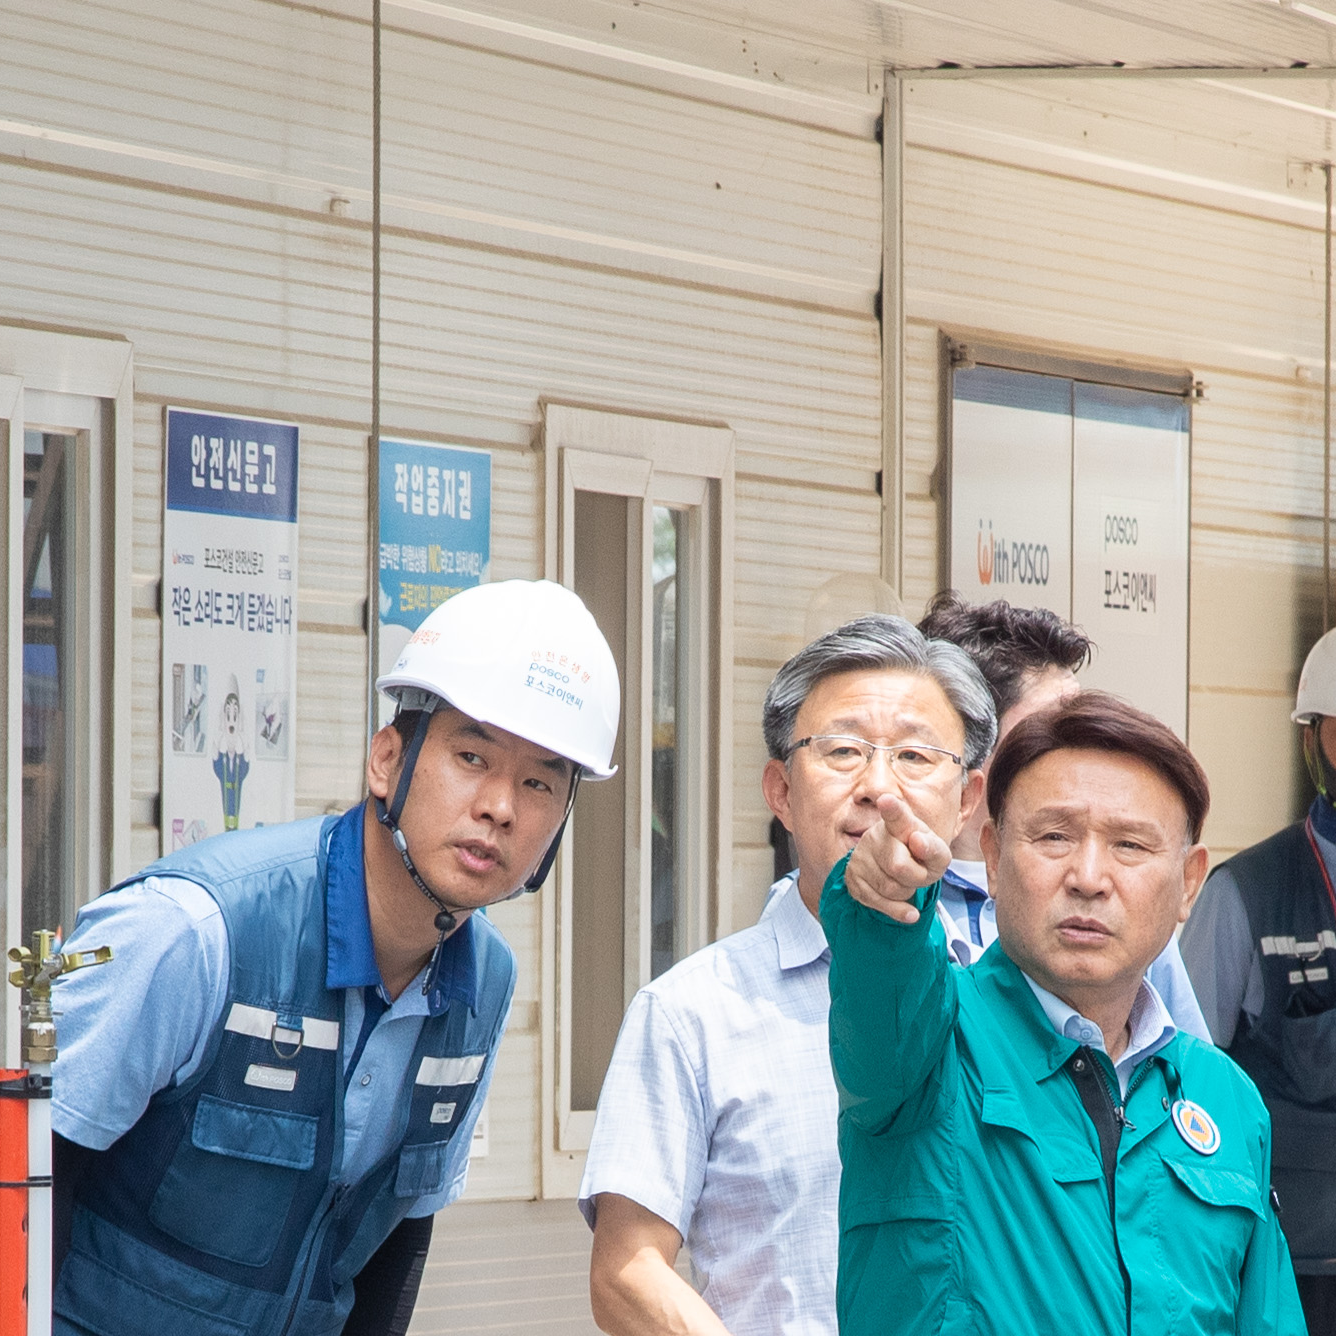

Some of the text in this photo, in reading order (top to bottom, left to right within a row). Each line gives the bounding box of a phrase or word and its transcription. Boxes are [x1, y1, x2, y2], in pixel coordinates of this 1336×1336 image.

[191, 434, 276, 495] 안전신문고
[395, 463, 471, 520] 작업중지권
[1104, 514, 1138, 552] posco
[1011, 541, 1050, 586] POSCO
[172, 585, 293, 635] 작은 소리도 크게 듣겠습니다
[1103, 570, 1157, 613] 포스코이앤씨
[524, 675, 584, 711] 포스코이앤씨
[529, 662, 570, 684] posco
